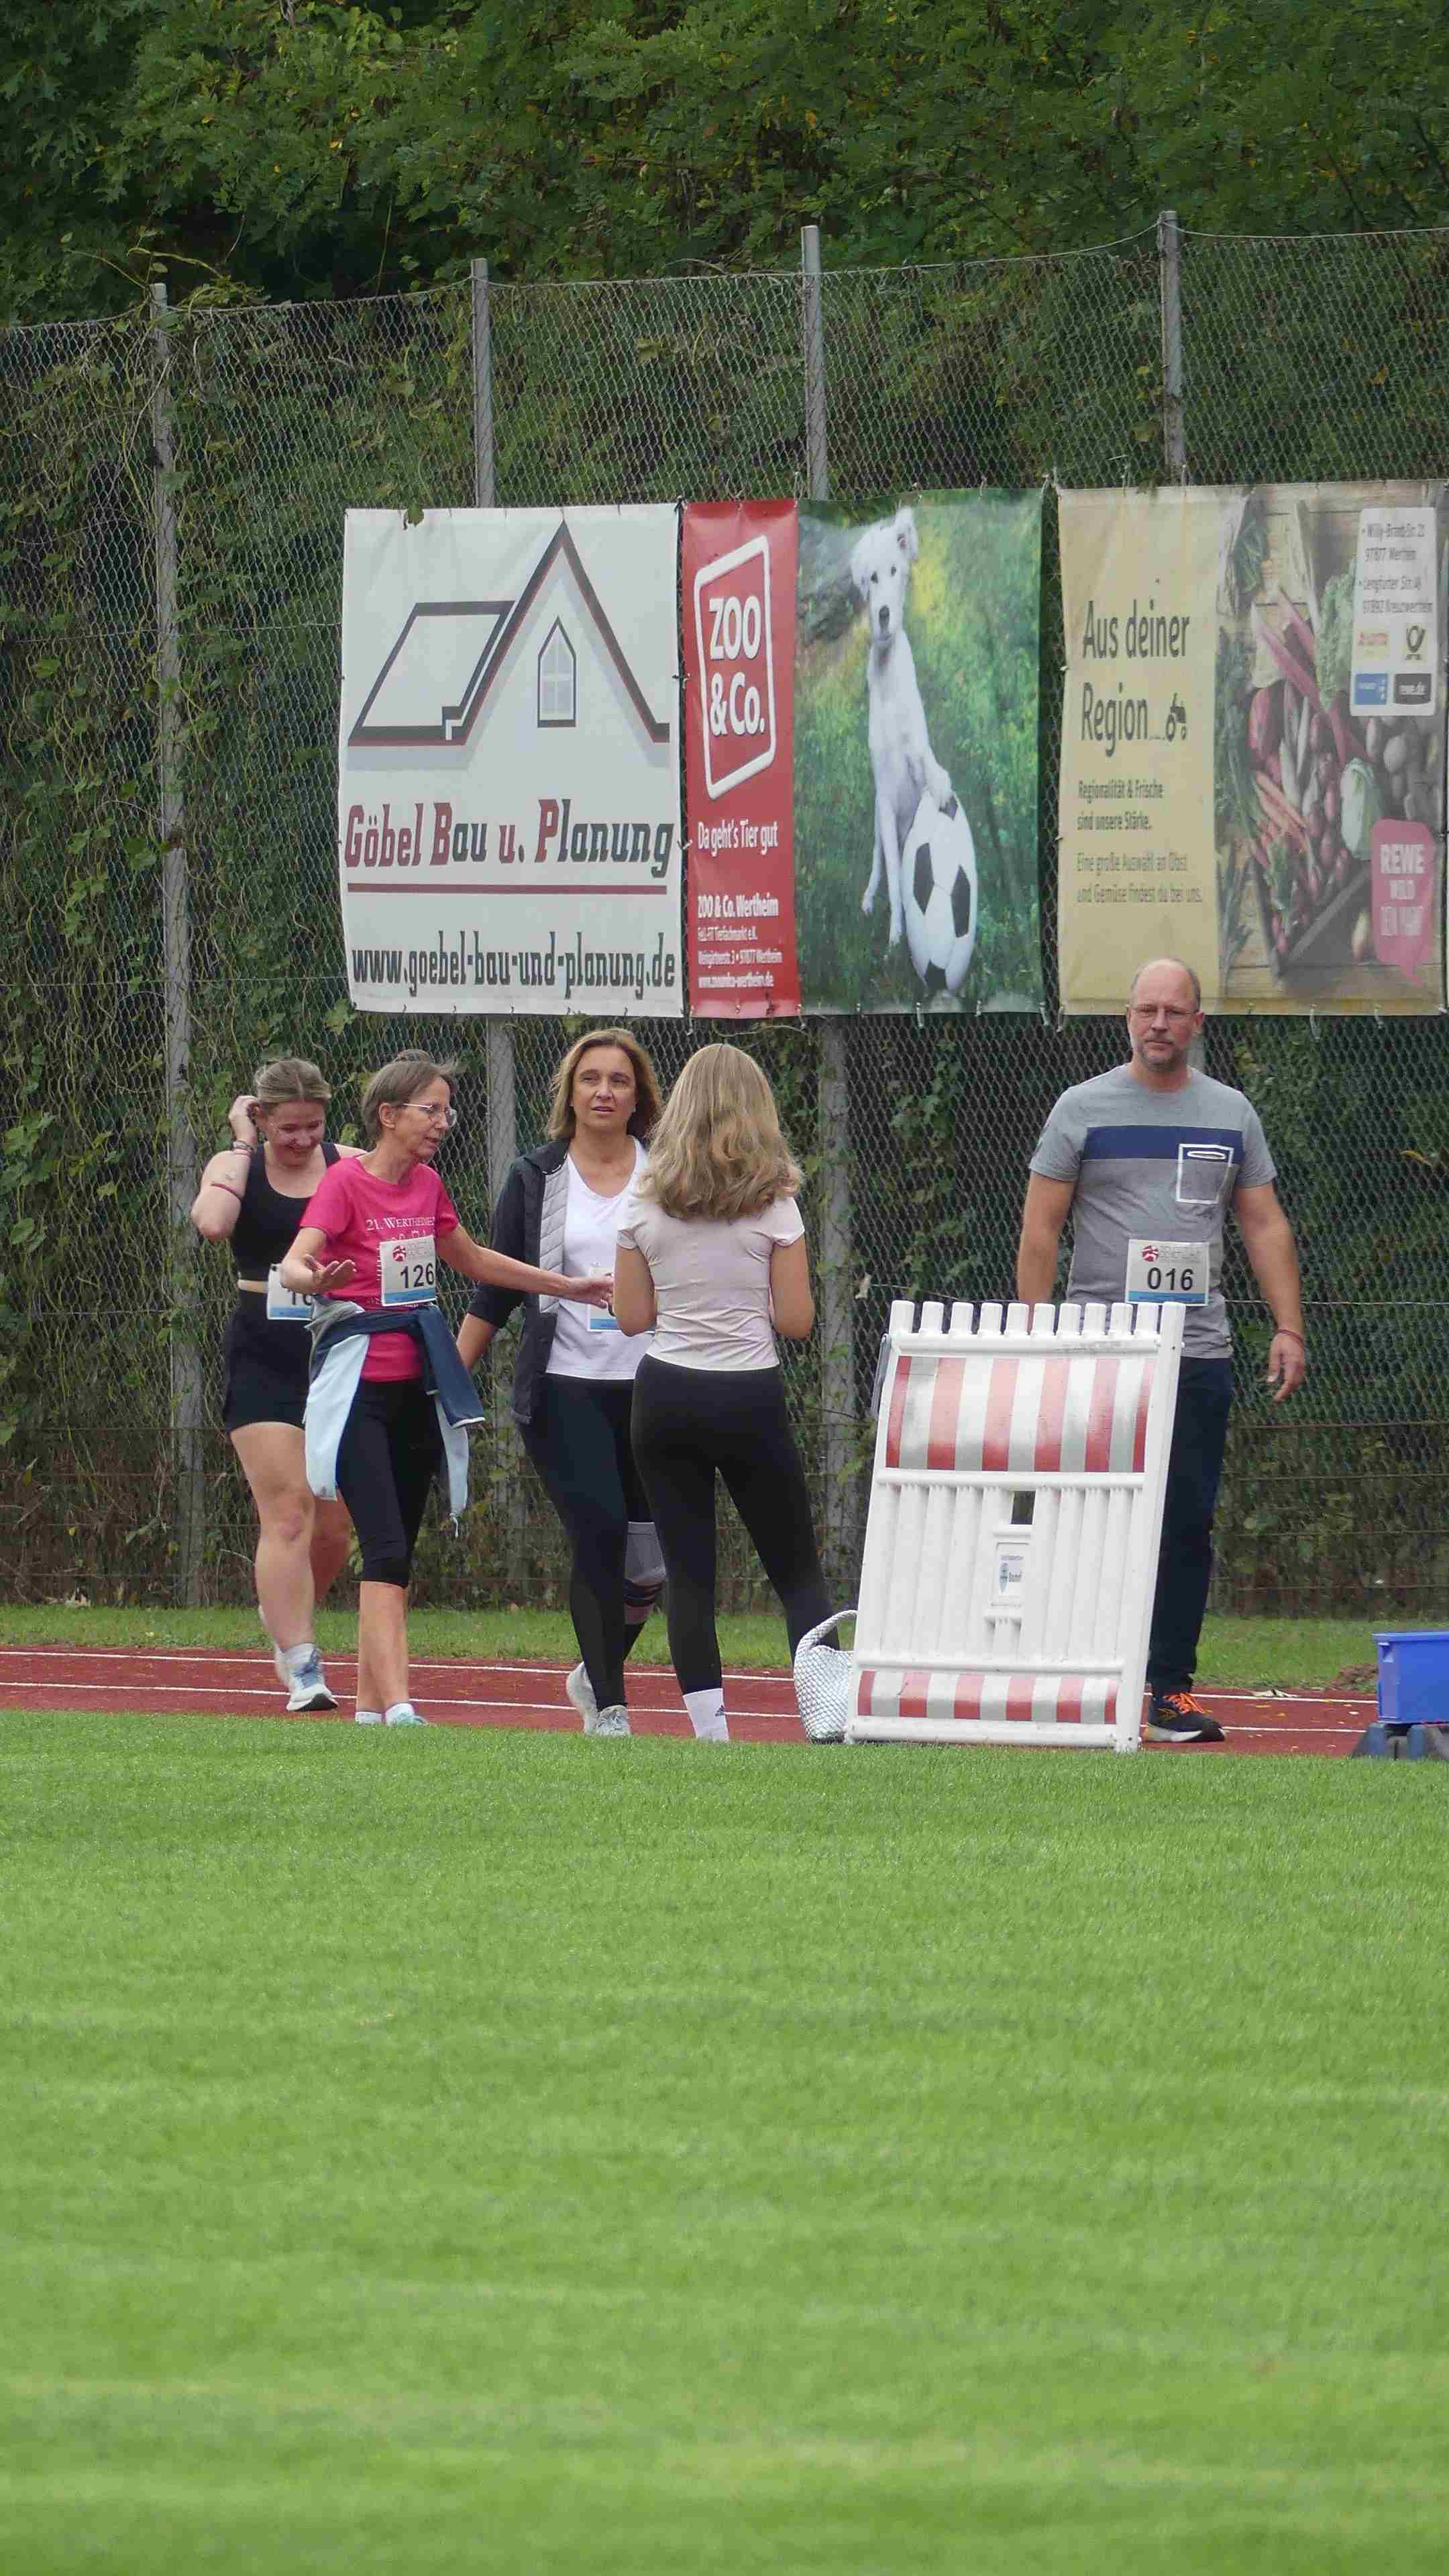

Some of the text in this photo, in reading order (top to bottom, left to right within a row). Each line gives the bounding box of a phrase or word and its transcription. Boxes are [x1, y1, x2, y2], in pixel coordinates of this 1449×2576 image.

[709, 596, 761, 660] ZOO
[1083, 598, 1190, 659] Aus deiner
[1081, 682, 1148, 757] Region
[1079, 778, 1163, 804] Regionalität & Frische
[1077, 810, 1093, 830] sind
[1095, 815, 1122, 830] unsere
[345, 799, 674, 879] Göbel Bau u. Planung
[698, 821, 710, 848] Da
[740, 820, 759, 847] Tier
[761, 822, 778, 855] gut
[1381, 844, 1425, 874] REWE
[736, 892, 778, 917] Wertheim
[352, 930, 676, 998] www.goebel-bau-und-planung.de
[366, 1219, 383, 1231] 21.
[400, 1263, 435, 1289] 126
[1147, 1267, 1194, 1291] 016
